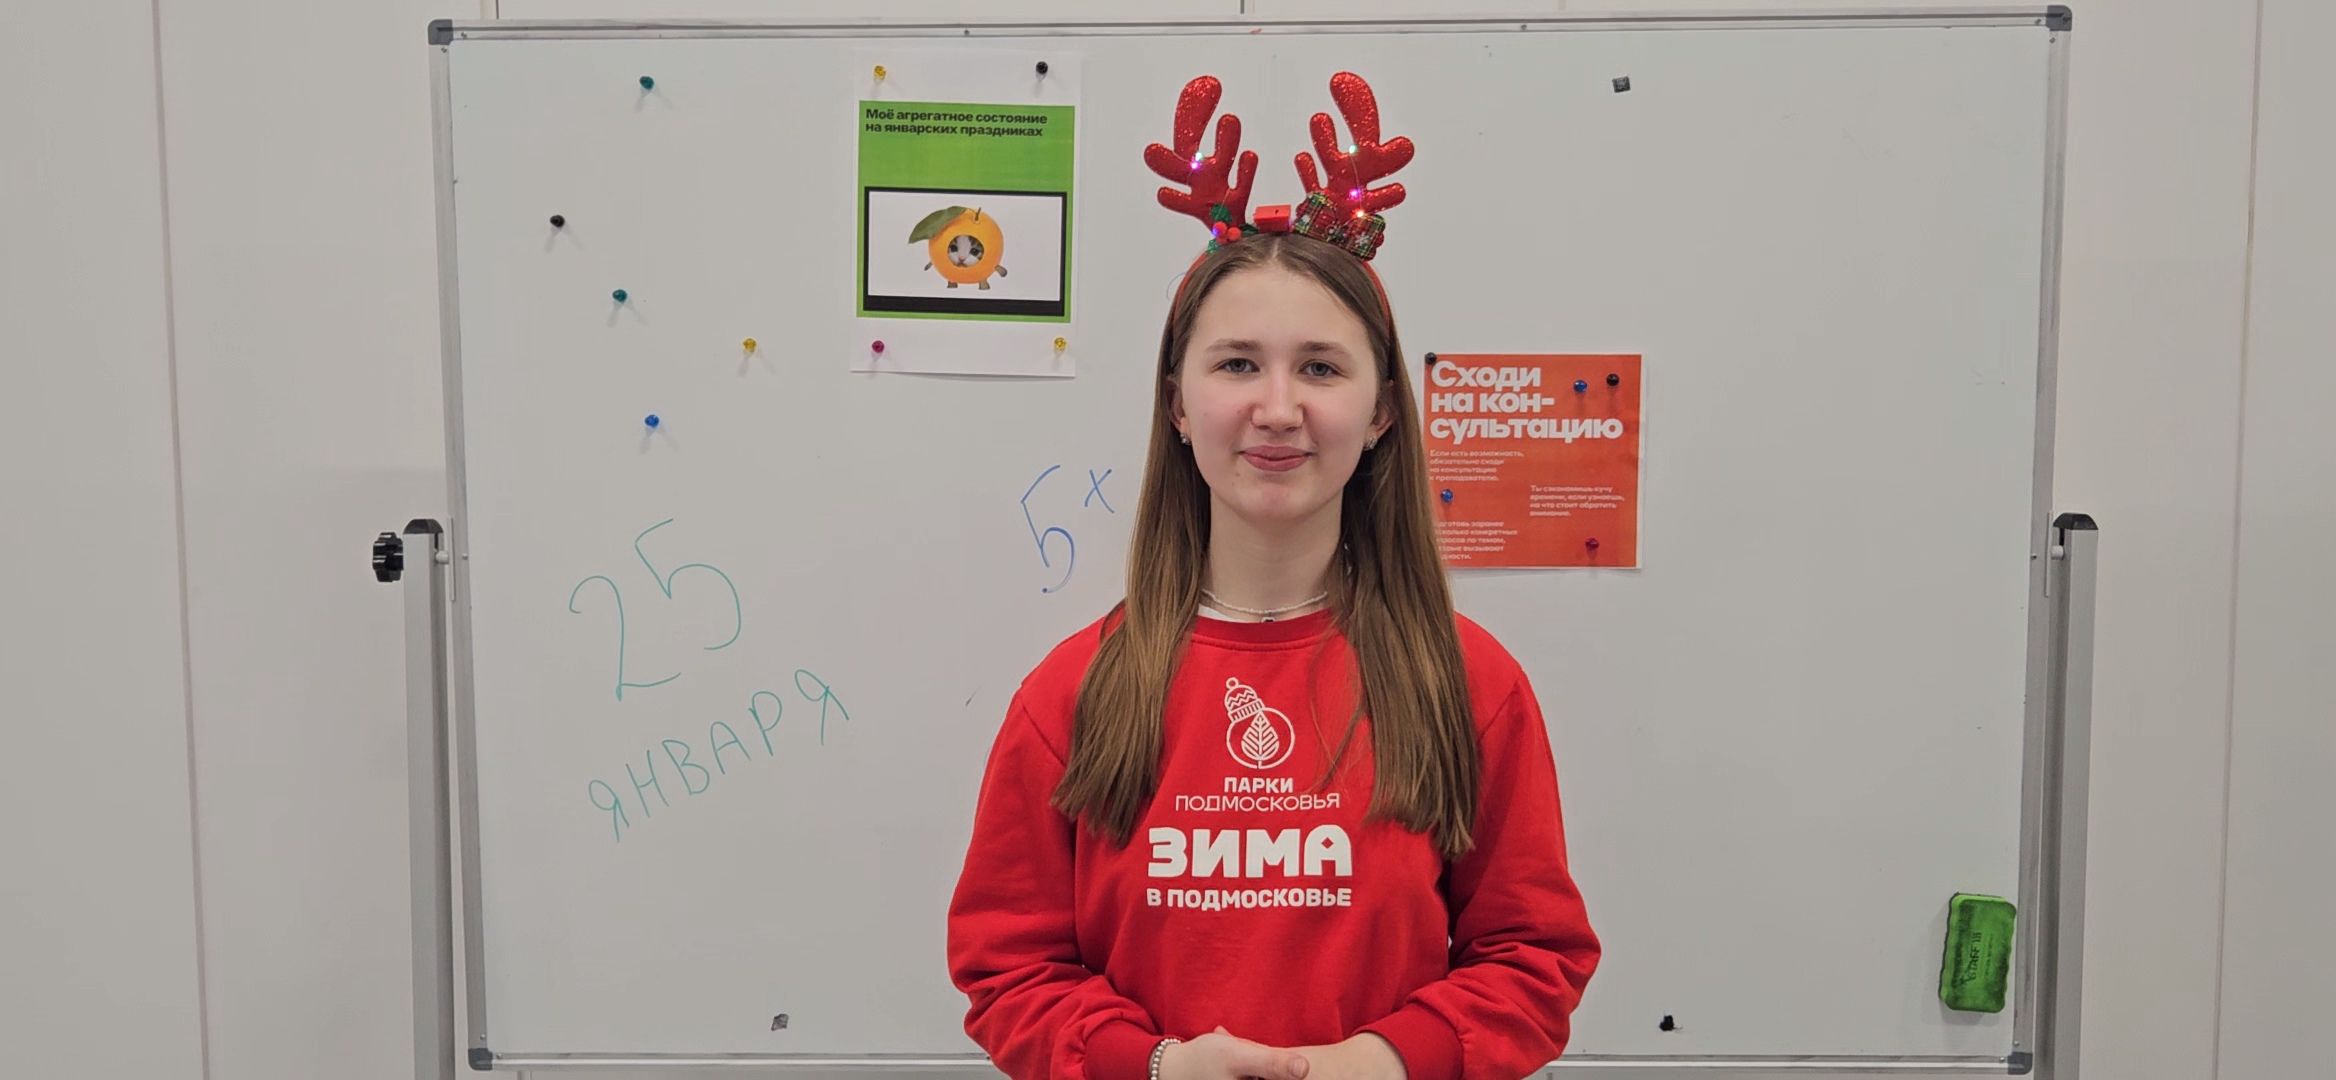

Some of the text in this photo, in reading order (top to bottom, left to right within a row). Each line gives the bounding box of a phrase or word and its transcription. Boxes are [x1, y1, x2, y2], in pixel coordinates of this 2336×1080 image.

[866, 108, 1048, 125] Моё агрегатное состояние
[865, 123, 1043, 137] на январских праздниках
[1431, 360, 1541, 392] Сходи
[1431, 393, 1555, 413] на кон-
[1430, 418, 1624, 445] сультацию
[568, 517, 742, 702] 25
[588, 668, 850, 844] ЯНВАРЯ
[1223, 777, 1294, 794] ПАРКИ
[1175, 792, 1341, 812] ПОДМОСКОВЬЯ
[1147, 824, 1353, 878] ЗИМА
[1146, 887, 1352, 912] В ПОДМОСКОВЬЕ
